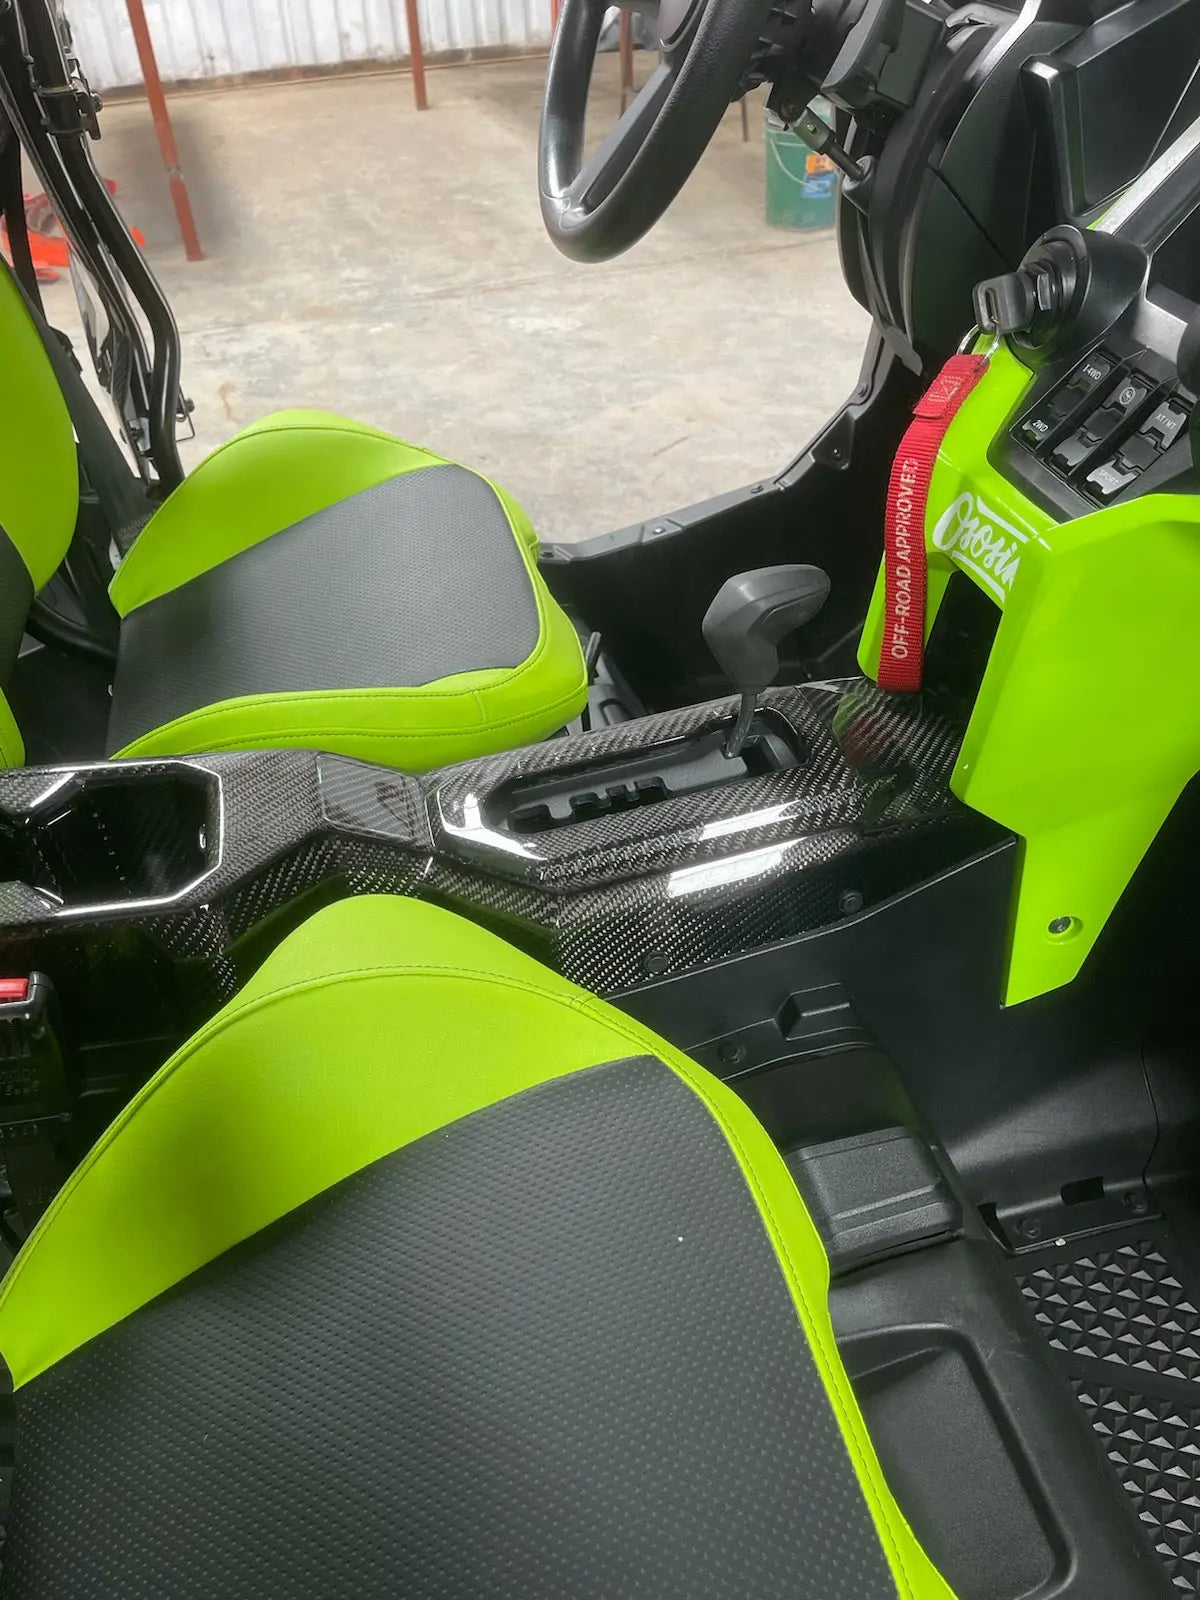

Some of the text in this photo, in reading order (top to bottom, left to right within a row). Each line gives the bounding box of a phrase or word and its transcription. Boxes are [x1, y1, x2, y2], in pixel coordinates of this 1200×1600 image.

[1032, 419, 1049, 432] 2WD
[1153, 413, 1177, 430] AT/MT
[891, 565, 912, 659] OFF-ROAD
